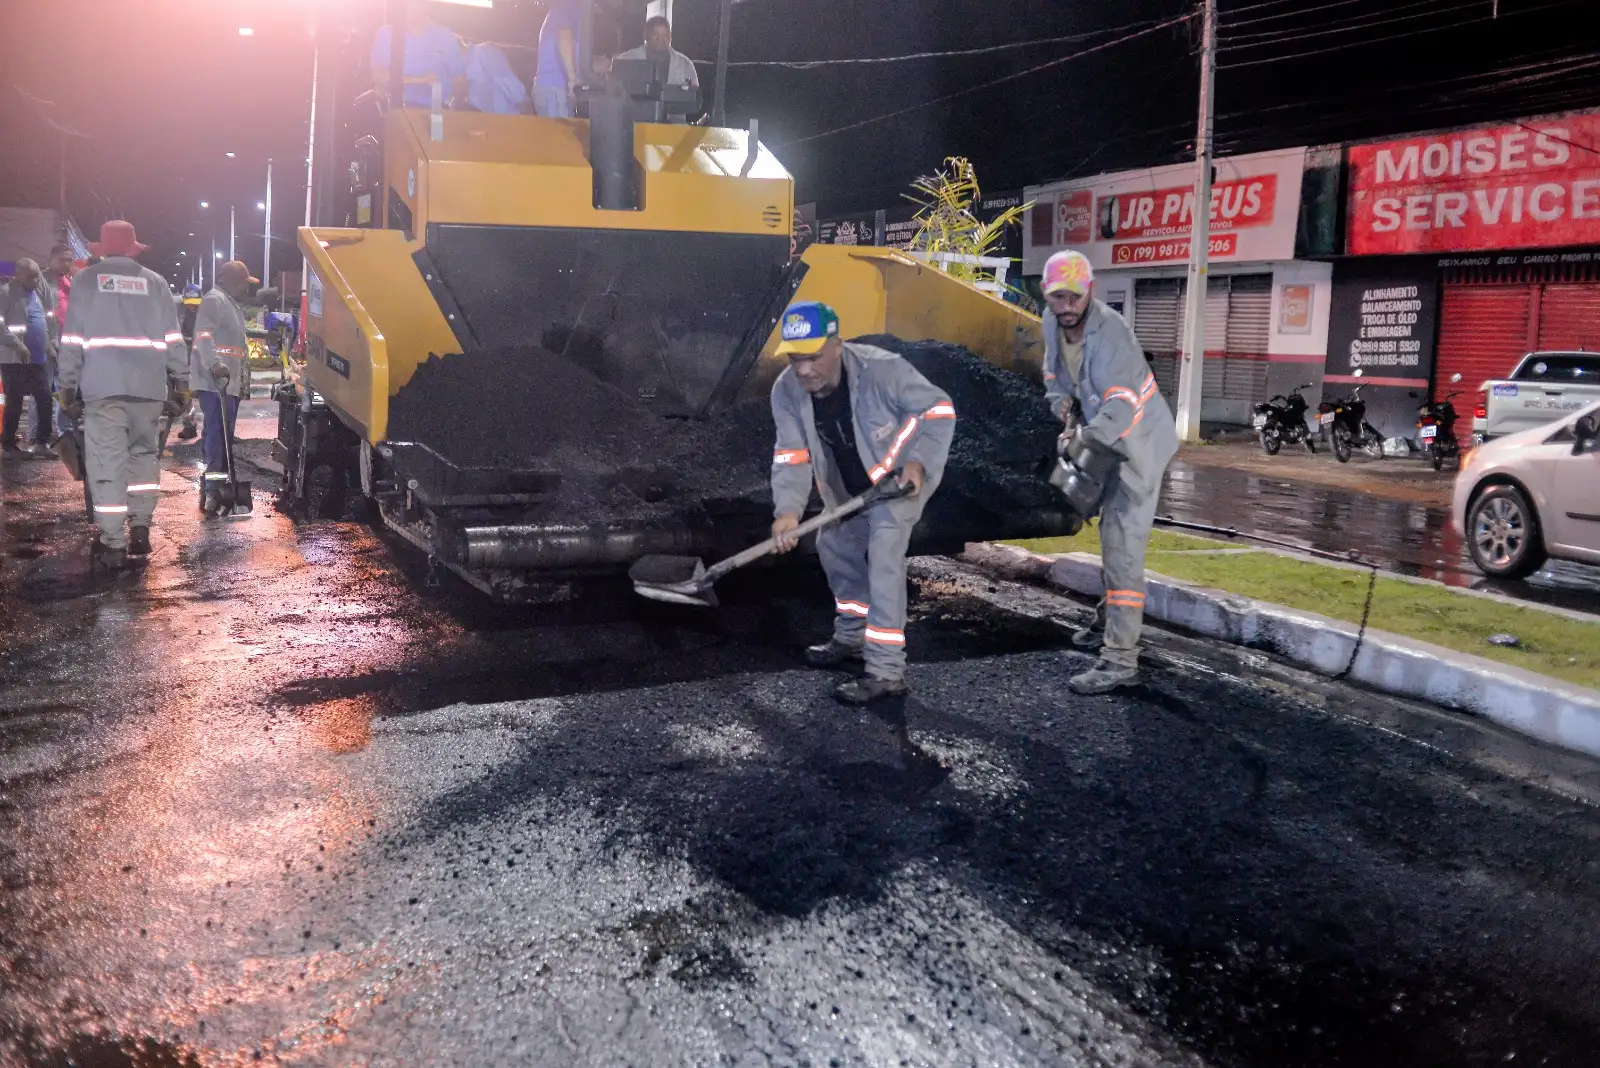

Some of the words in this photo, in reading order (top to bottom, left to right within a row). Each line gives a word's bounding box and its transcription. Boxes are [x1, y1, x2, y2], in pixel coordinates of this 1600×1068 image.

[1375, 125, 1572, 184] MOISÉS
[1120, 196, 1154, 230] JR
[1161, 182, 1263, 225] PNEUS
[1372, 179, 1600, 233] SERVICE
[1142, 226, 1176, 237] SERVIÇOS
[1177, 220, 1232, 233] AUTTIVOS
[1134, 246, 1156, 261] (99)
[1438, 257, 1491, 267] DEIXAMOS
[1497, 256, 1518, 265] SEU
[1523, 254, 1559, 264] CARRO
[1363, 286, 1418, 301] ALINHAMENTO
[1361, 300, 1422, 313] BALANCEAMENTO
[1362, 314, 1386, 326] TROCA
[1387, 313, 1397, 325] DE
[1398, 311, 1418, 324] ÓLEO
[1361, 327, 1366, 338] E
[1367, 325, 1412, 338] EMBREAGEM
